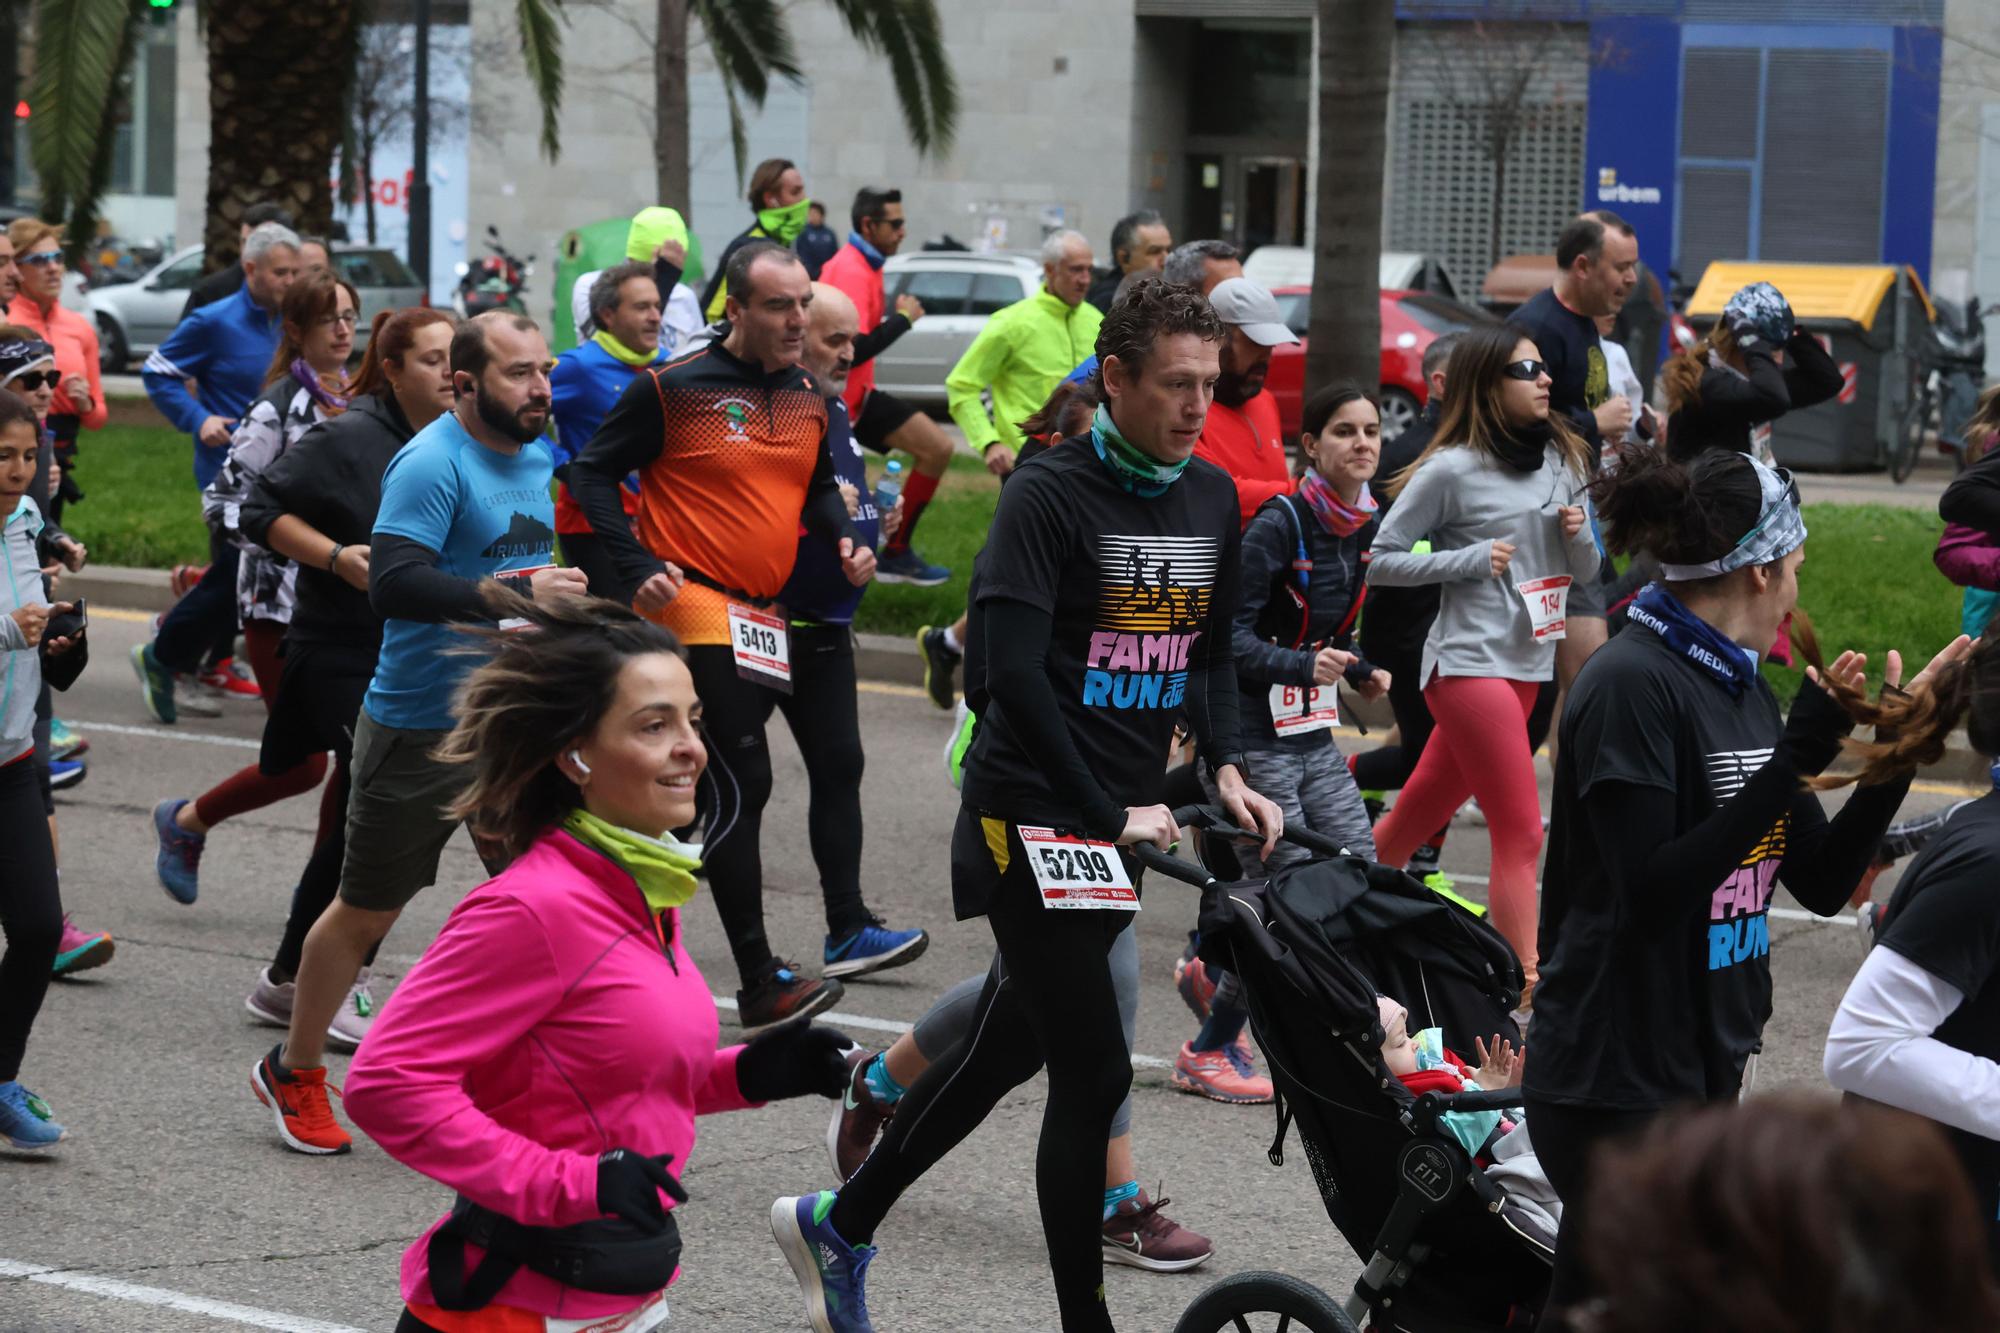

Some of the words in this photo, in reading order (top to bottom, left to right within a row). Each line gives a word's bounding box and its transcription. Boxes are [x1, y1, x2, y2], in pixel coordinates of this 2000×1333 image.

[740, 623, 777, 656] 5413
[1083, 669, 1164, 709] RUN
[1039, 847, 1114, 883] 5299
[1707, 914, 1770, 971] RUN
[1414, 1162, 1441, 1185] FIT
